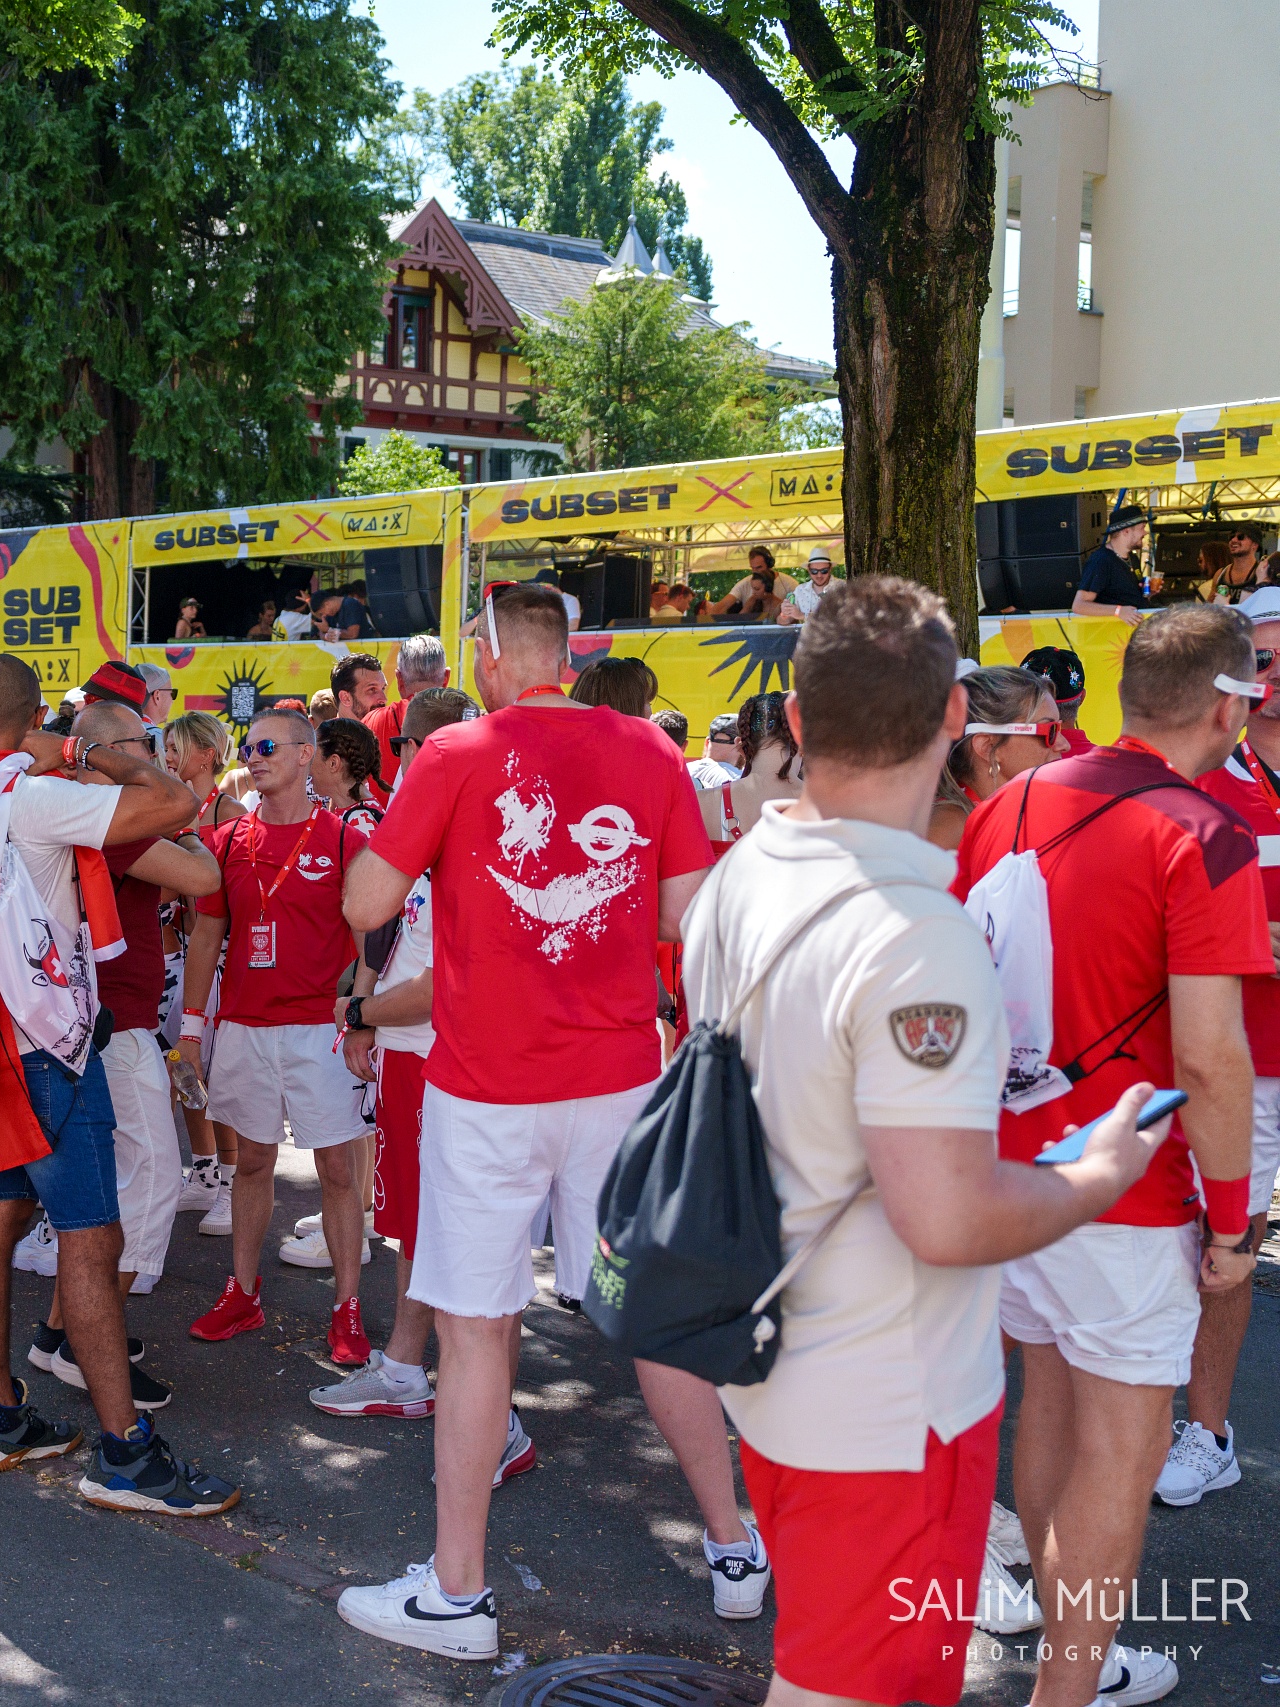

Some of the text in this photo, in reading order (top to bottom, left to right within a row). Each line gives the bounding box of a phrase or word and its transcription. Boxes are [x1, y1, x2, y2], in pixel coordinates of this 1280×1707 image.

[1006, 423, 1273, 479] SUBSET
[501, 484, 678, 524] SUBSET
[779, 474, 834, 497] MA:
[154, 520, 280, 551] SUBSET
[3, 585, 81, 617] SUB
[3, 615, 81, 646] SET
[31, 658, 70, 683] A:X
[725, 1558, 745, 1569] NIKE
[727, 1567, 742, 1576] AIR
[456, 1645, 470, 1654] AIR
